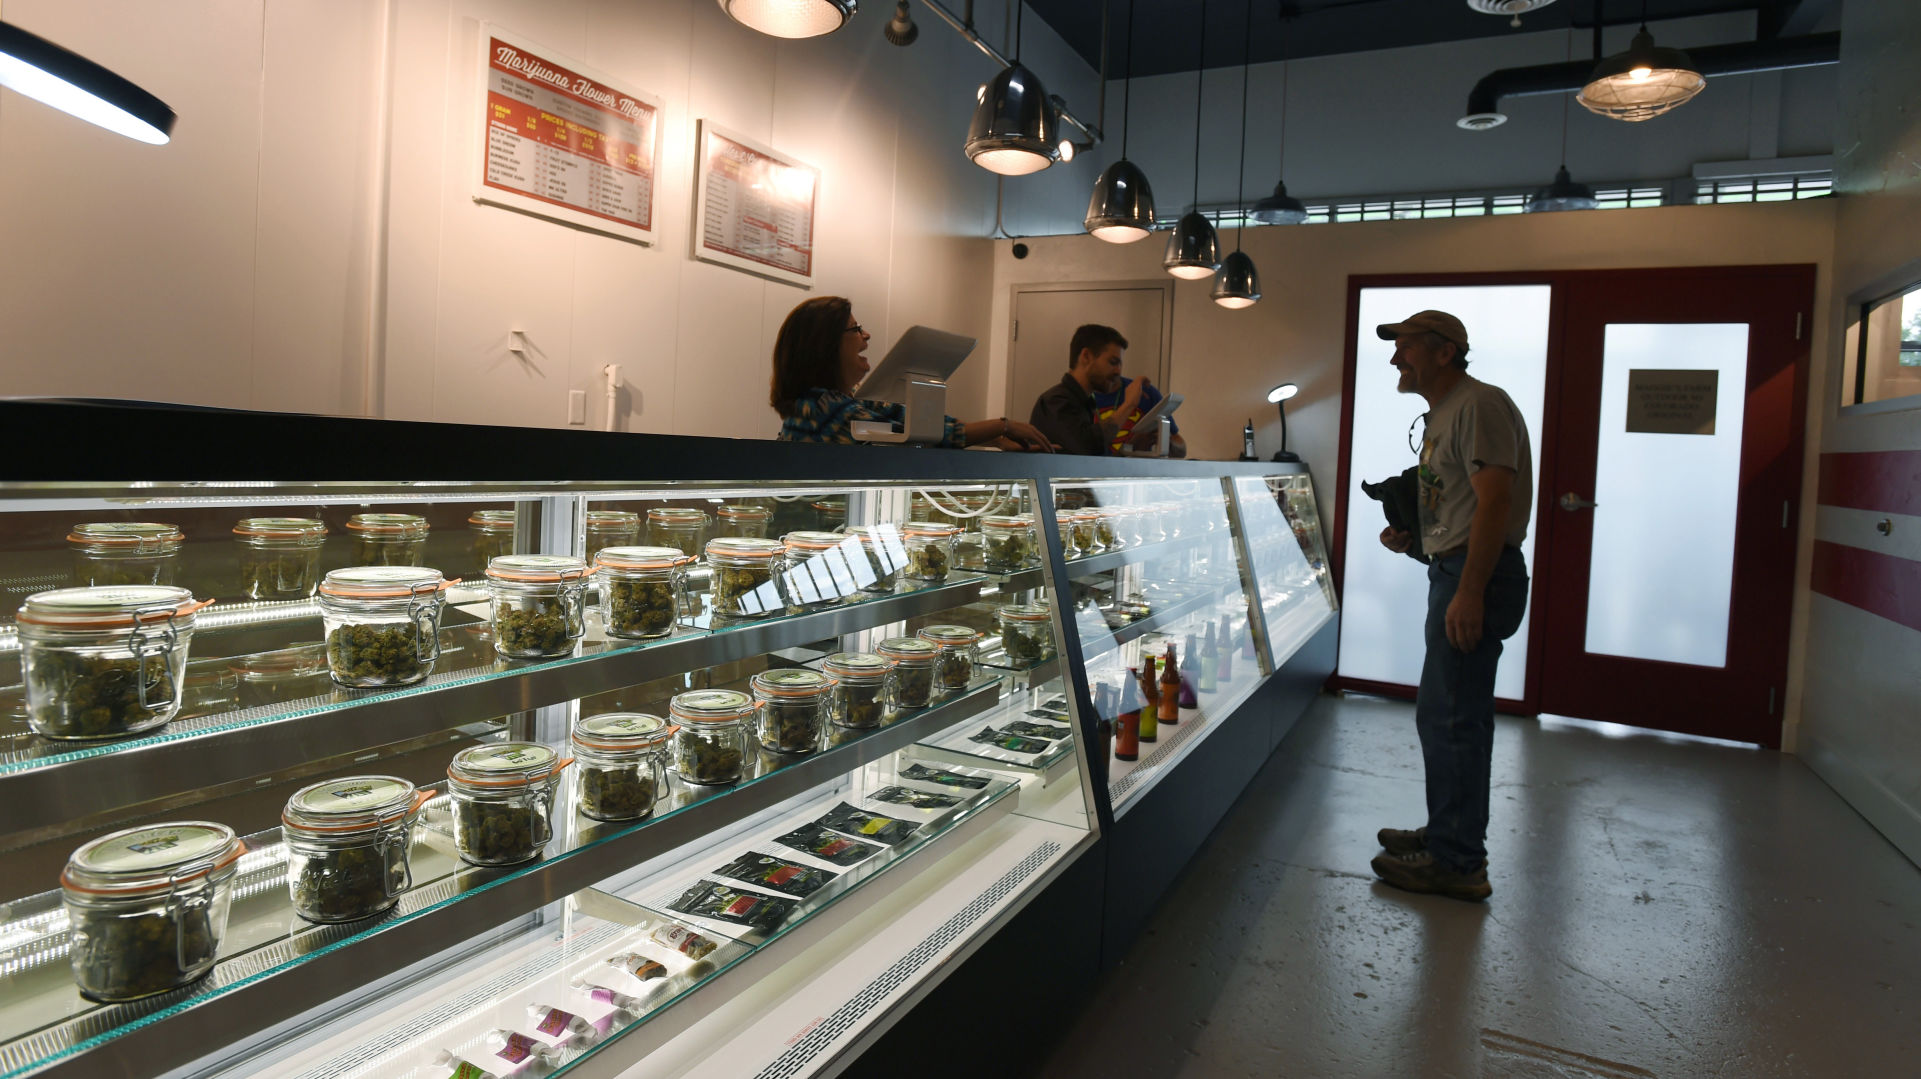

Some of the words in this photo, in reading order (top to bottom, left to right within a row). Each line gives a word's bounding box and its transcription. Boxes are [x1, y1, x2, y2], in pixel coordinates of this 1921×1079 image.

[496, 47, 570, 88] Marijuana
[573, 79, 617, 107] Flower
[620, 98, 652, 120] Menu
[541, 112, 564, 127] PRICES
